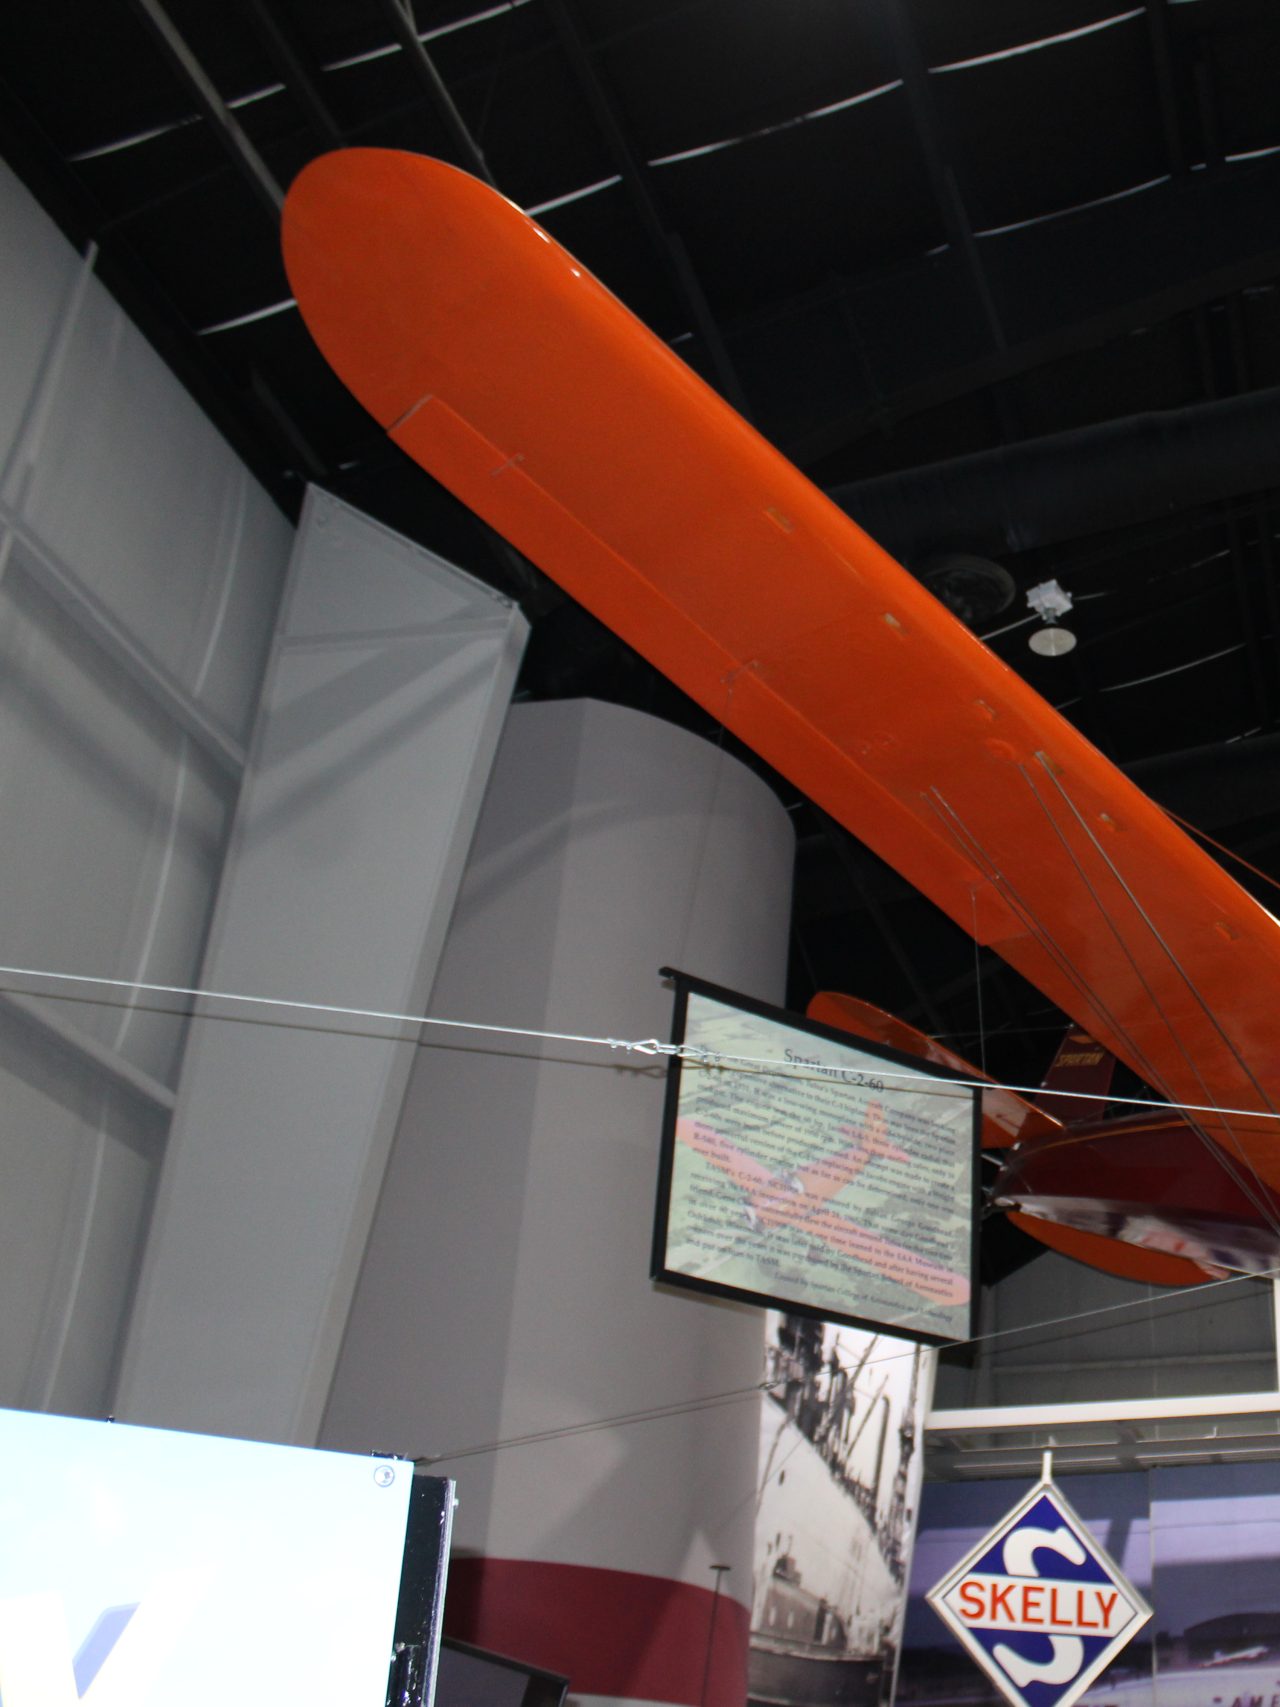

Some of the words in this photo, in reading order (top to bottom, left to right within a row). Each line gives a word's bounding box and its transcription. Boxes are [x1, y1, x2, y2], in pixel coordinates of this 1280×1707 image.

[783, 1048, 838, 1078] Spartan
[841, 1068, 884, 1093] C-2-60
[959, 1581, 1118, 1629] SKELLY
